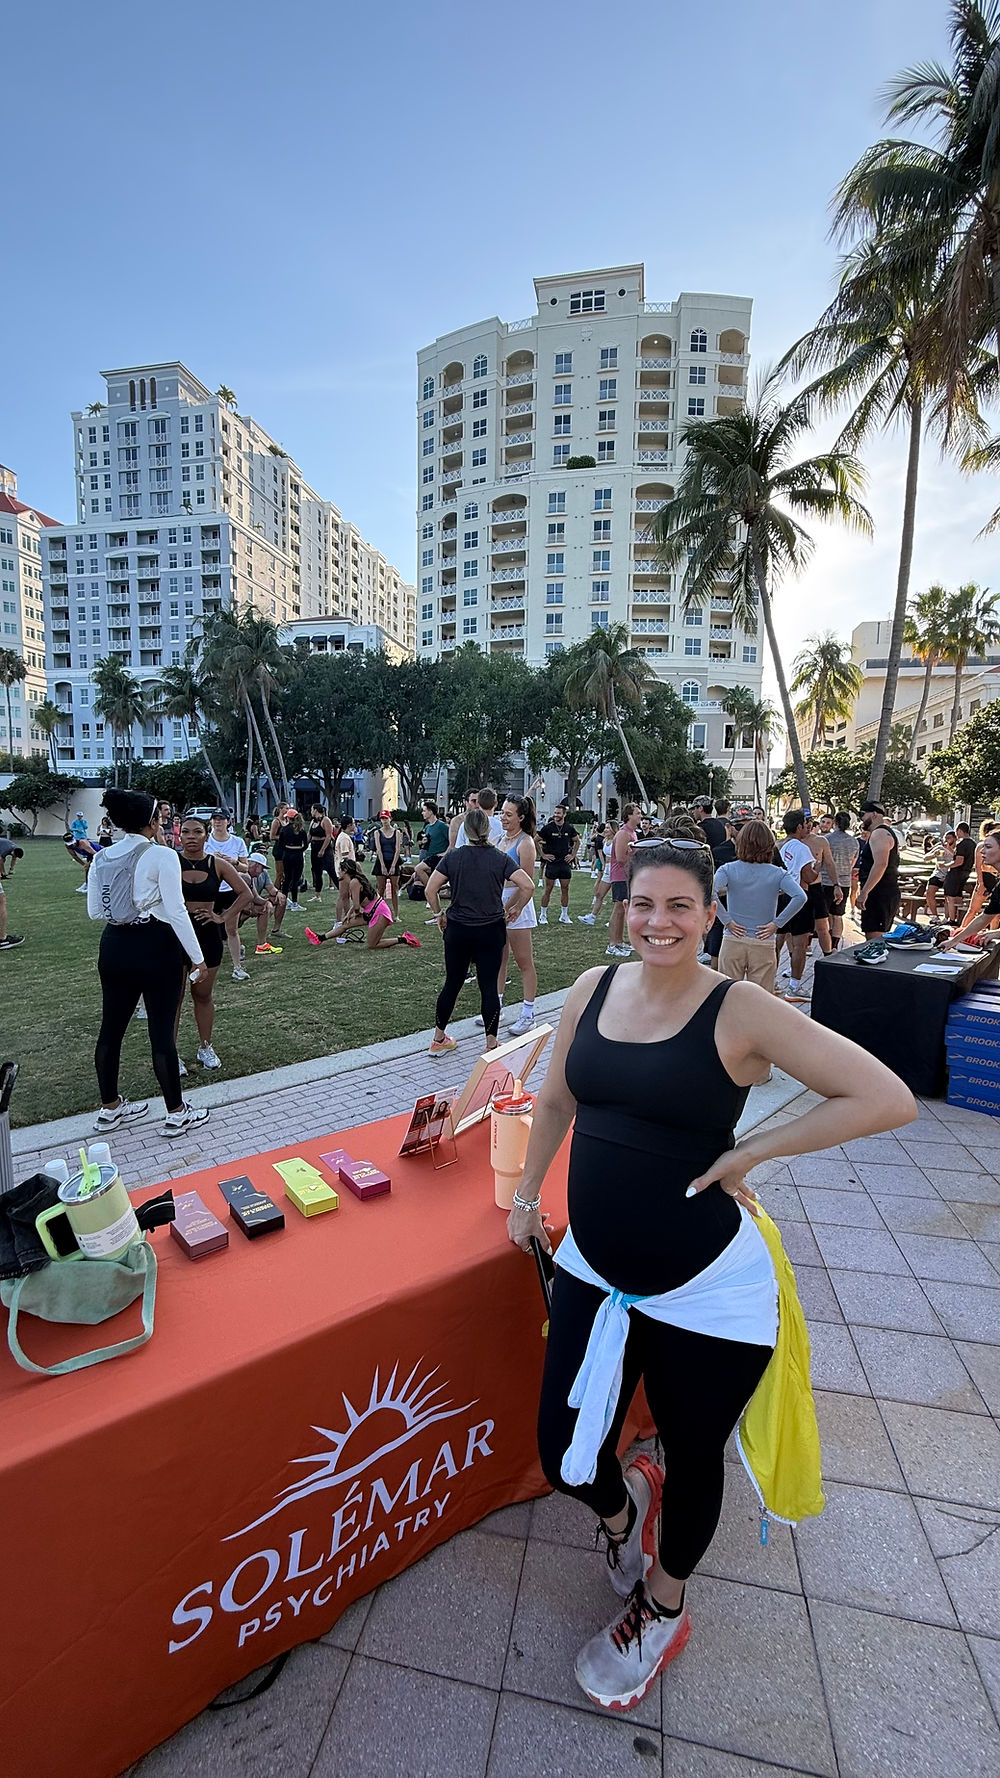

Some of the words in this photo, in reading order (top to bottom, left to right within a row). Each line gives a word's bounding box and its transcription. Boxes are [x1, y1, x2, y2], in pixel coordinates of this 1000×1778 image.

[964, 1036, 1000, 1048] BROOK
[168, 1419, 495, 1654] SOLÉMAR
[238, 1492, 451, 1648] PSYCHIATRY
